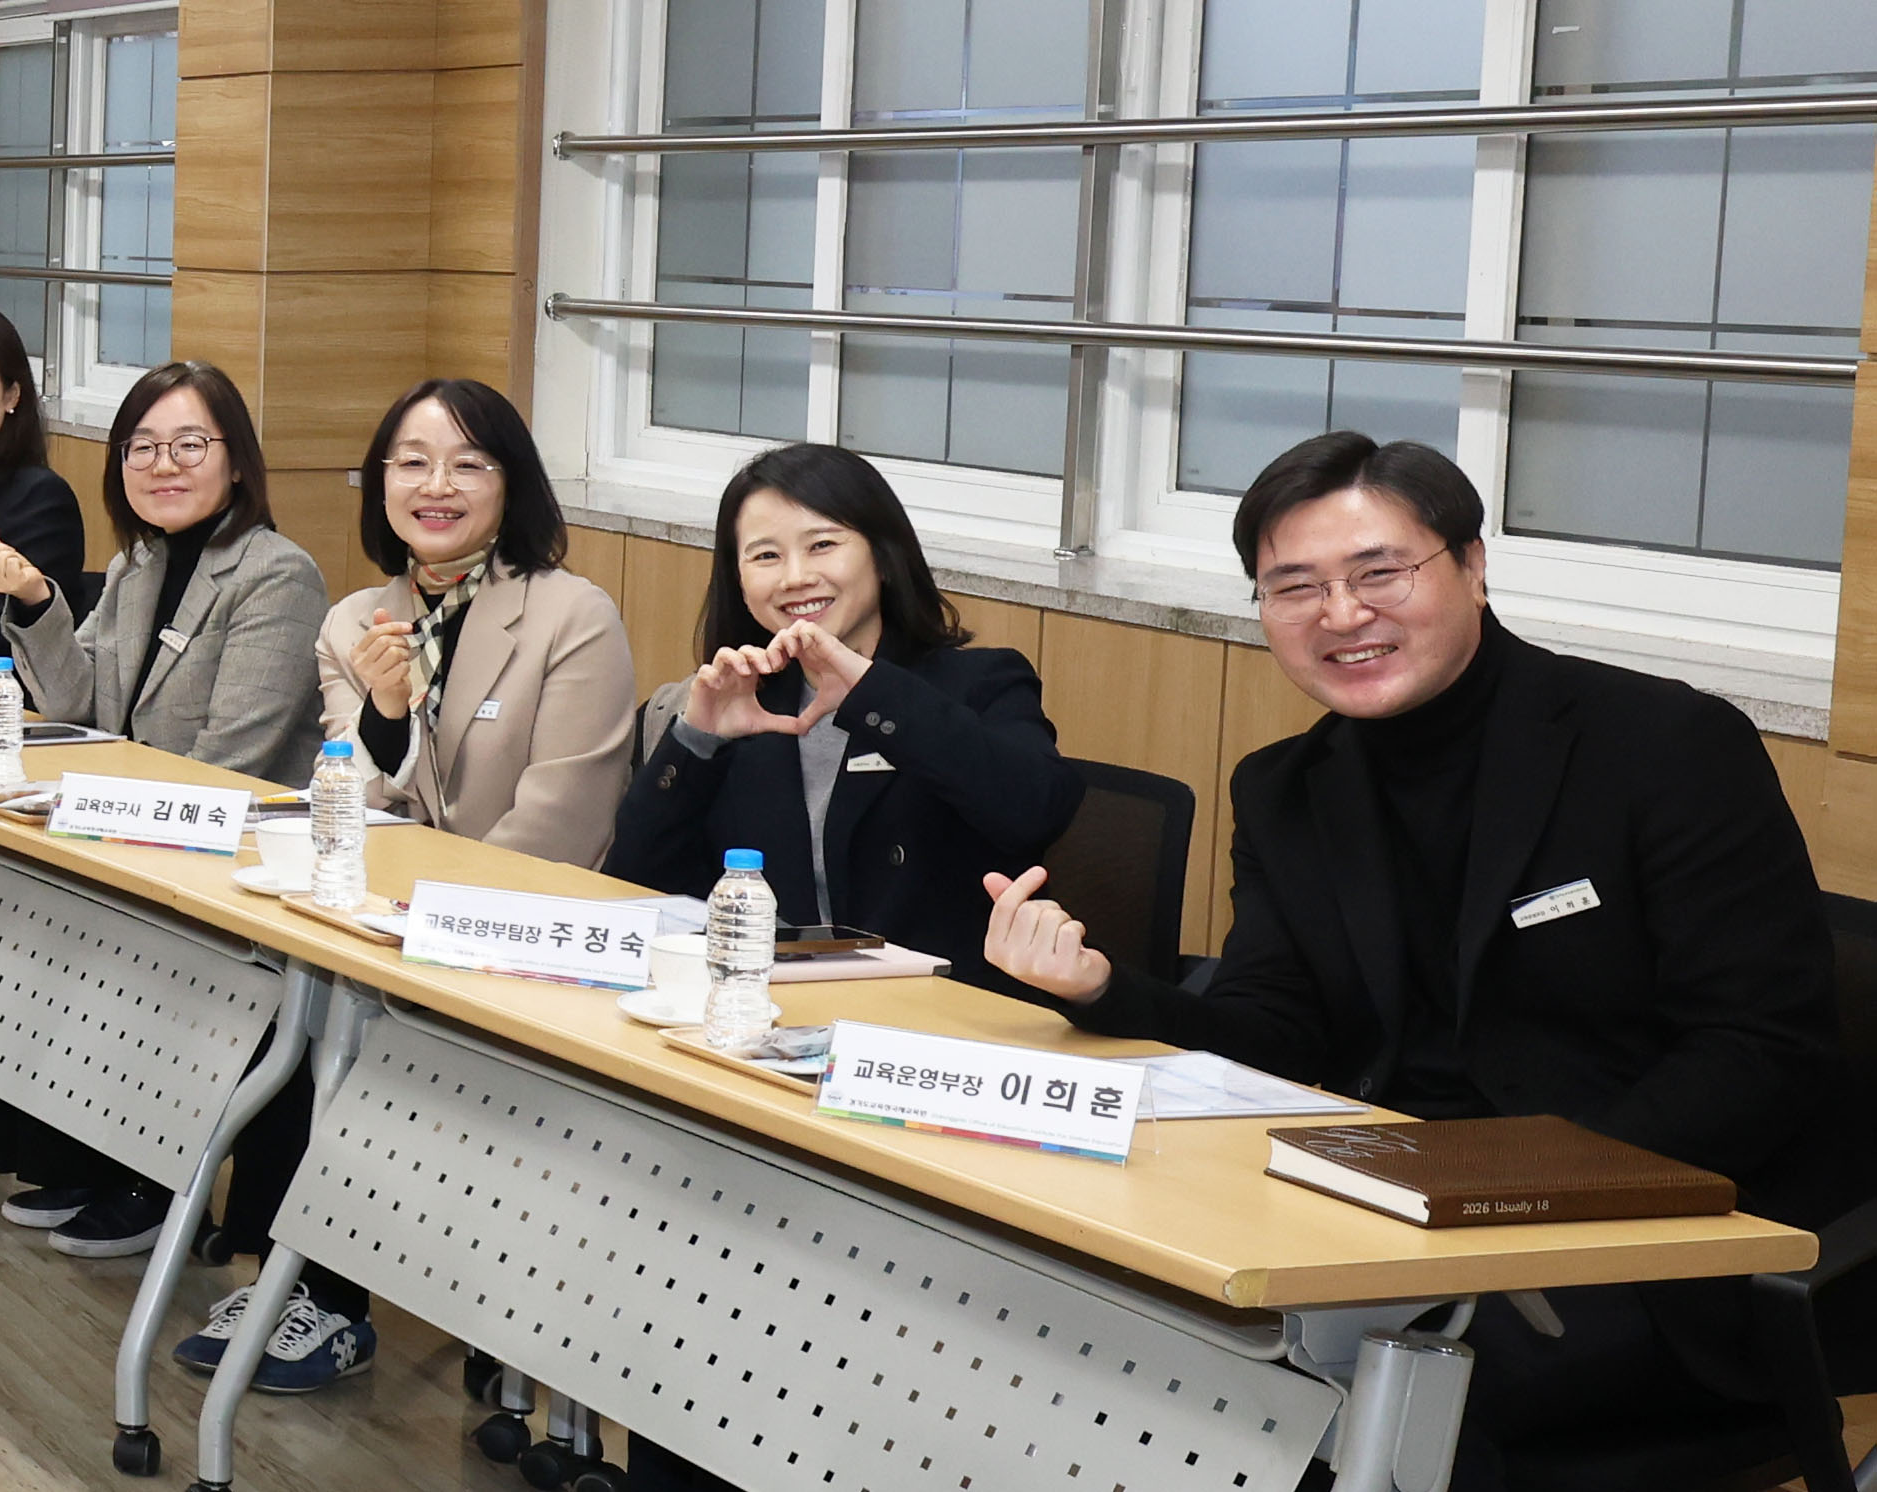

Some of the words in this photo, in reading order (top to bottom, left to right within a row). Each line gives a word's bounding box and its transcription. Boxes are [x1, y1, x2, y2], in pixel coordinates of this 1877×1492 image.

[74, 797, 142, 818] 교육연구사
[425, 912, 542, 945] 교육운영부팀장
[853, 1058, 984, 1097] 교육운영부장
[1462, 1201, 1490, 1215] 2026
